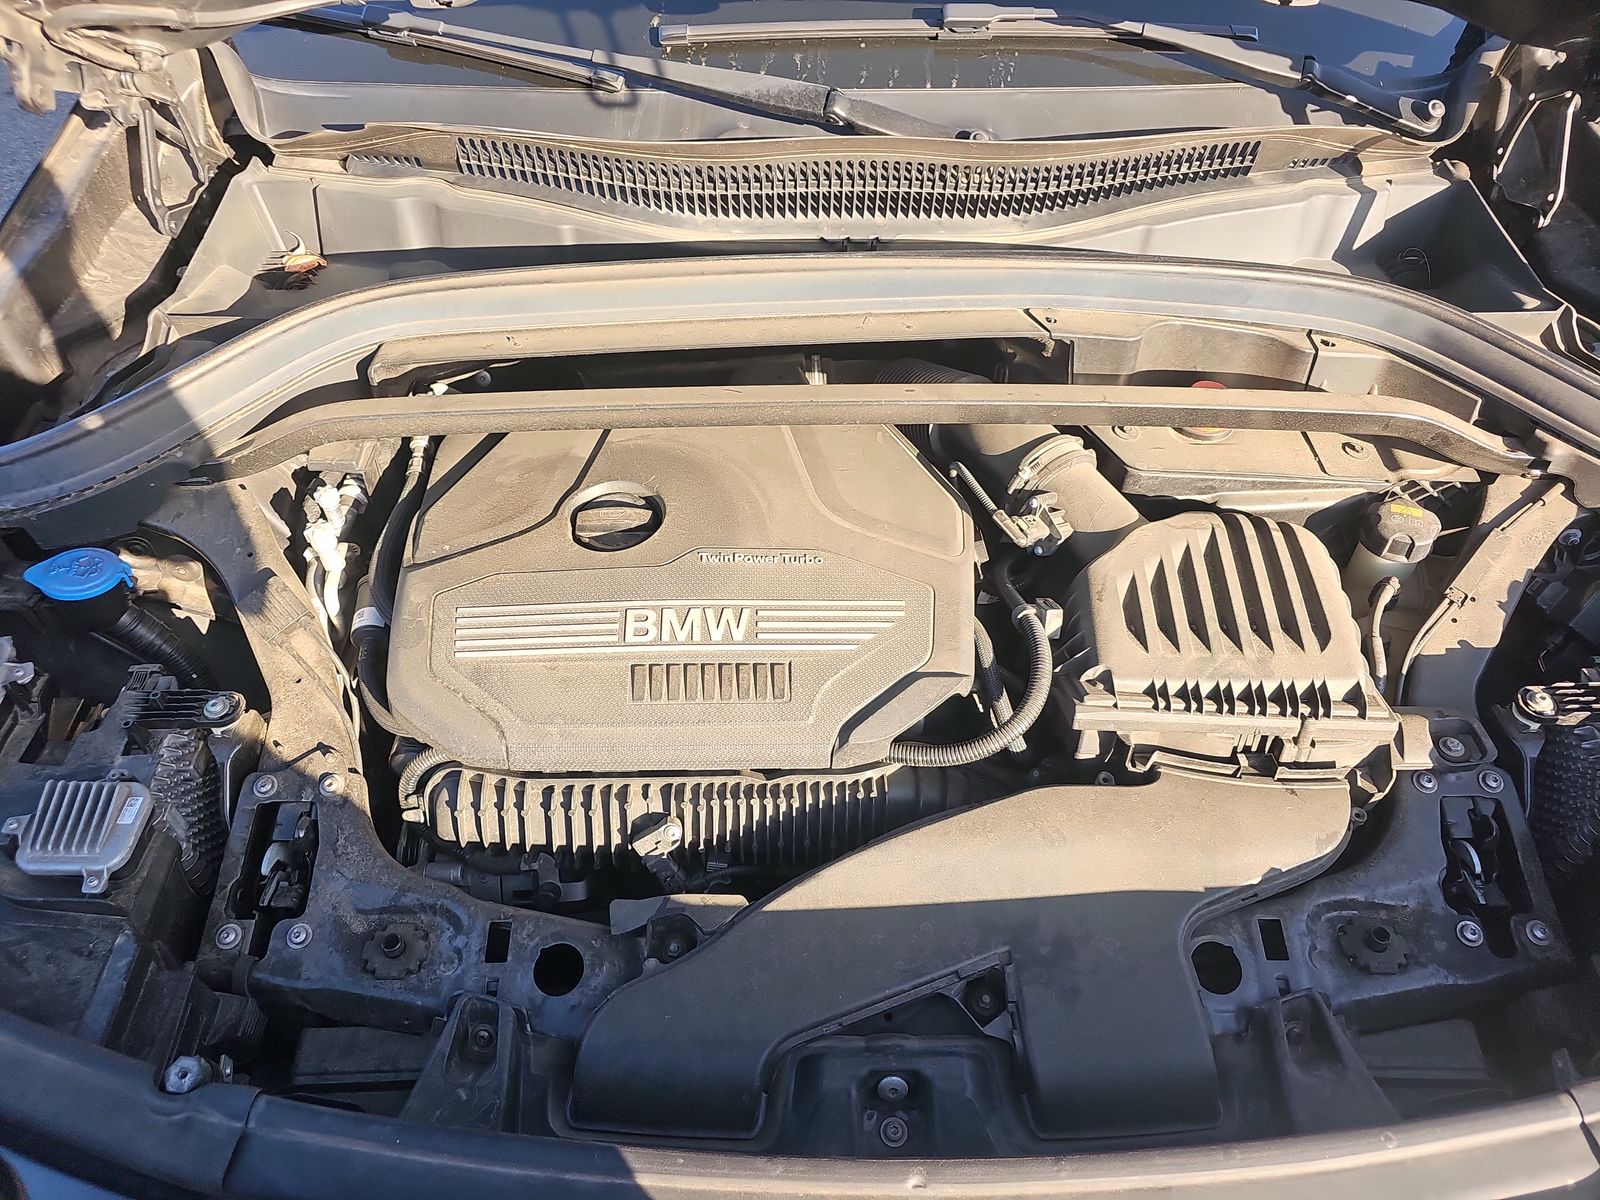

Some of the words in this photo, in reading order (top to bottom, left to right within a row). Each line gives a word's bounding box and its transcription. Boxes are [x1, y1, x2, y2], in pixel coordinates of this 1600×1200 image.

[698, 552, 779, 564] TwinPower
[780, 553, 824, 565] Turbo
[624, 607, 750, 643] BMW
